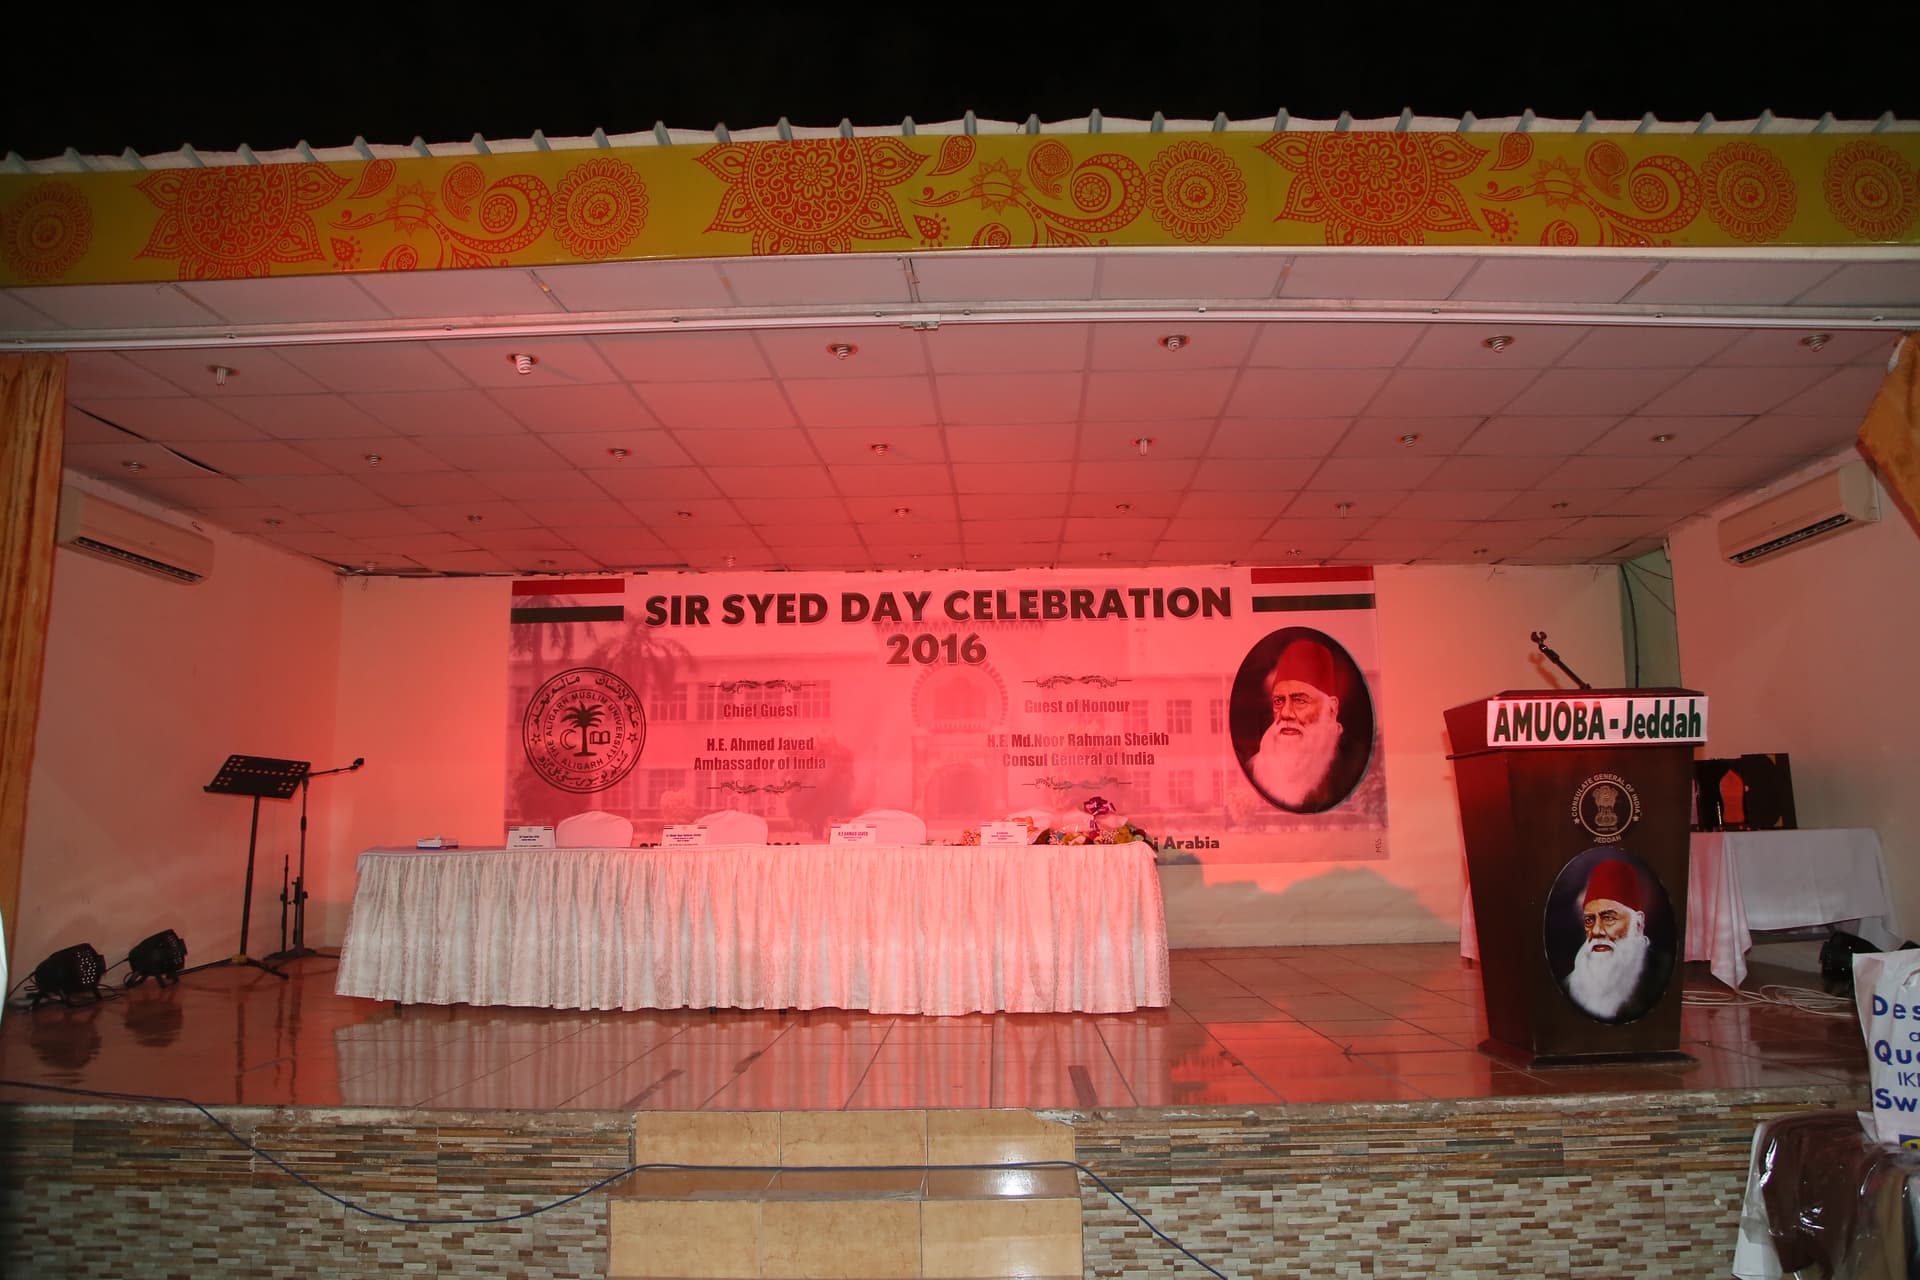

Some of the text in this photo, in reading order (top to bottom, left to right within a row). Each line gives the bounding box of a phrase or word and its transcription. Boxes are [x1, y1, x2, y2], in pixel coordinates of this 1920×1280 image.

[644, 586, 1232, 626] SIR SYED DAY CELEBRATION
[886, 633, 988, 665] 2016
[723, 703, 798, 718] Chief Guest
[1024, 699, 1130, 713] Guest of Honour
[547, 740, 560, 759] THE
[571, 691, 608, 704] MUSLIM
[607, 703, 624, 760] UNIVERSITY
[1493, 701, 1606, 742] AMUOBA
[1622, 699, 1702, 740] Jeddah
[707, 737, 814, 751] H.E. Ahmed Javed
[1068, 733, 1121, 747] Rahman
[1124, 732, 1170, 746] Sheikh
[561, 758, 604, 770] ALIGARH
[694, 756, 826, 771] Ambassador of India
[1003, 751, 1155, 767] Consul General of India
[1571, 777, 1594, 817] CONSULATE
[1593, 773, 1625, 786] GENERAL
[1631, 793, 1641, 814] INDIA
[1163, 835, 1220, 850] Arabia
[1593, 834, 1622, 844] JEDDAH
